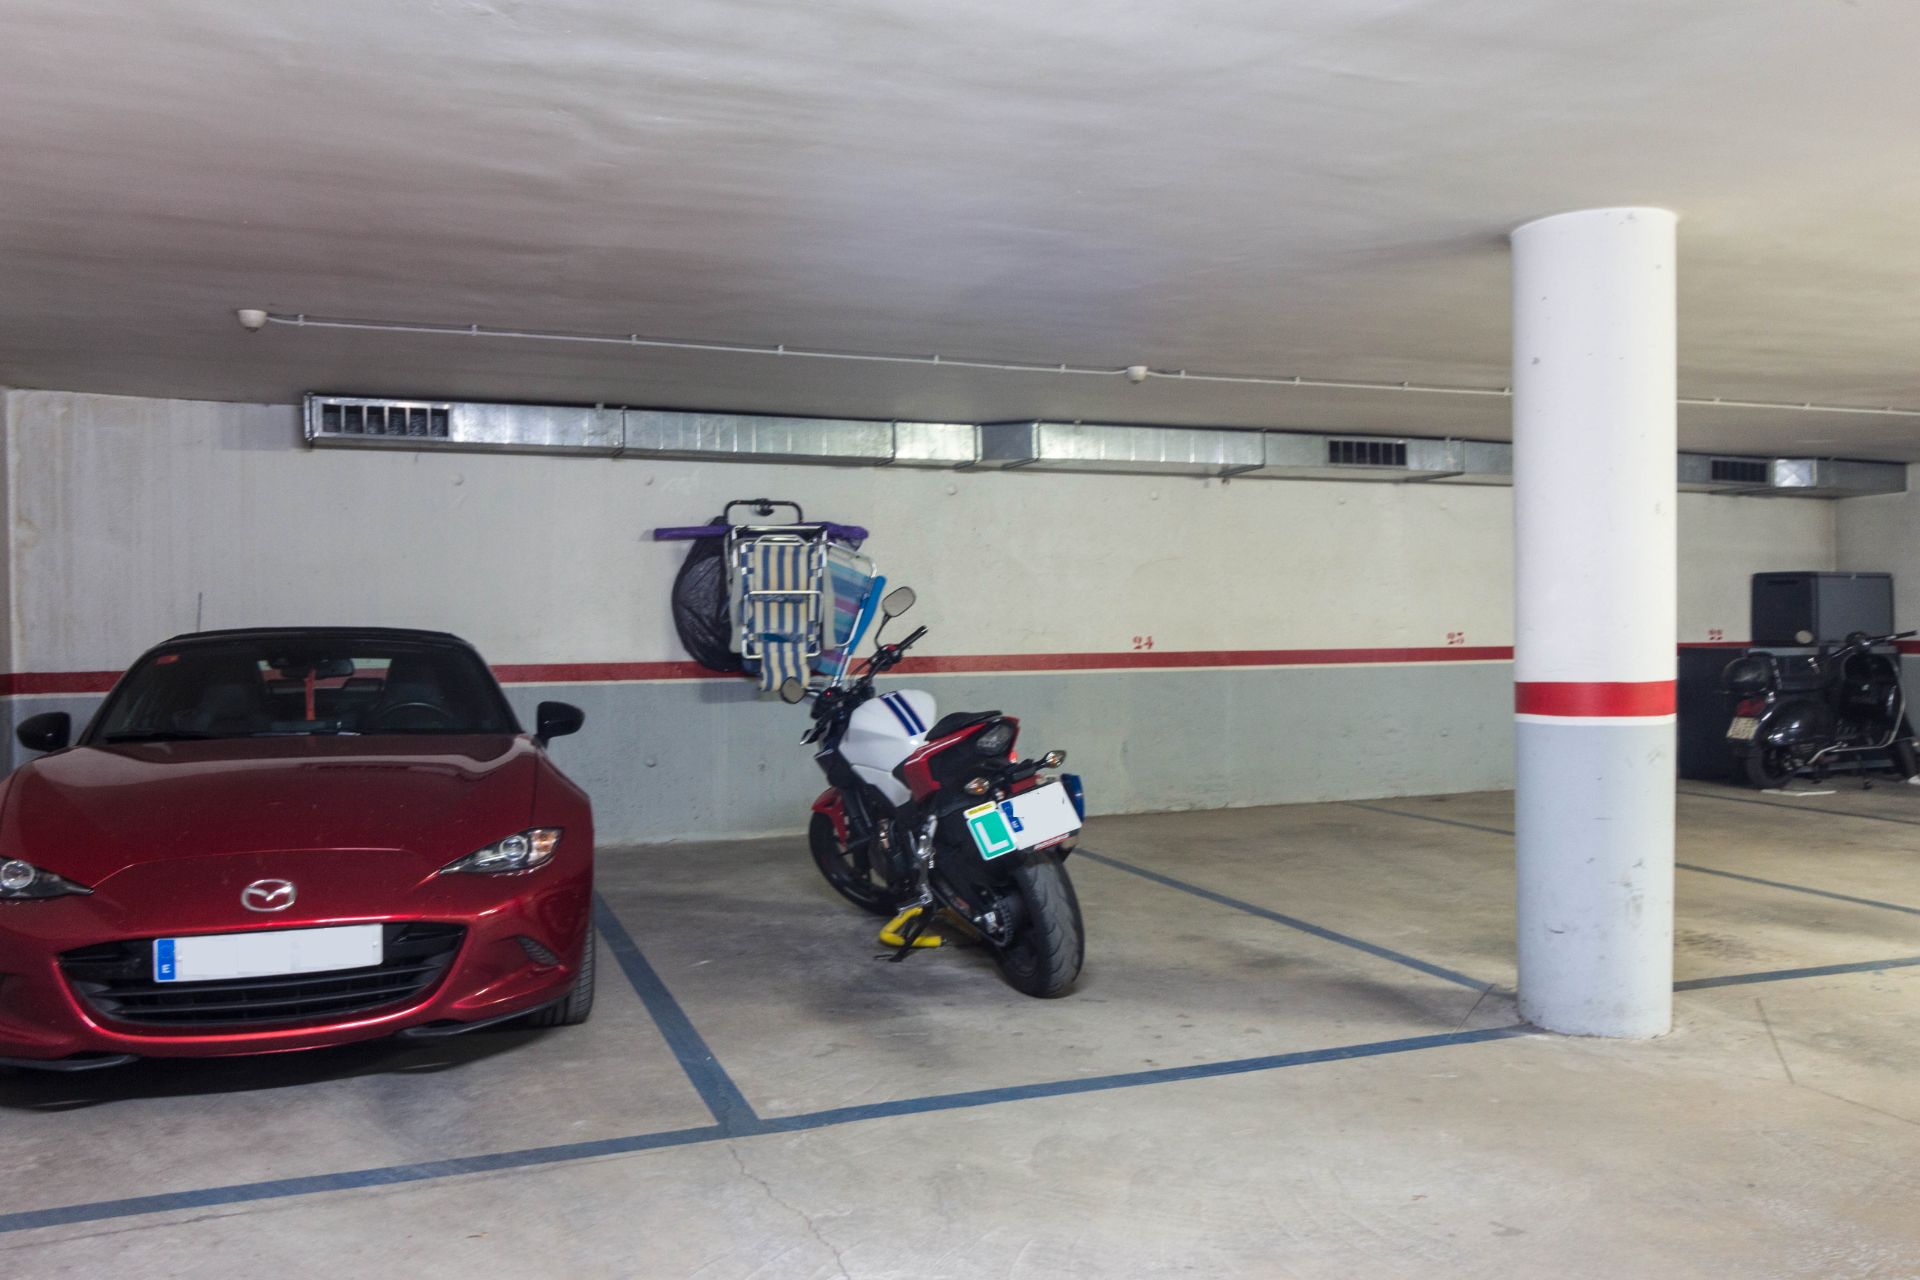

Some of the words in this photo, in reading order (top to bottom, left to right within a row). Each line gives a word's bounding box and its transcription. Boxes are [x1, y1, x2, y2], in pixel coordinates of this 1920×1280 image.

[1132, 635, 1154, 650] 24
[975, 821, 1010, 854] L
[161, 963, 171, 974] E
